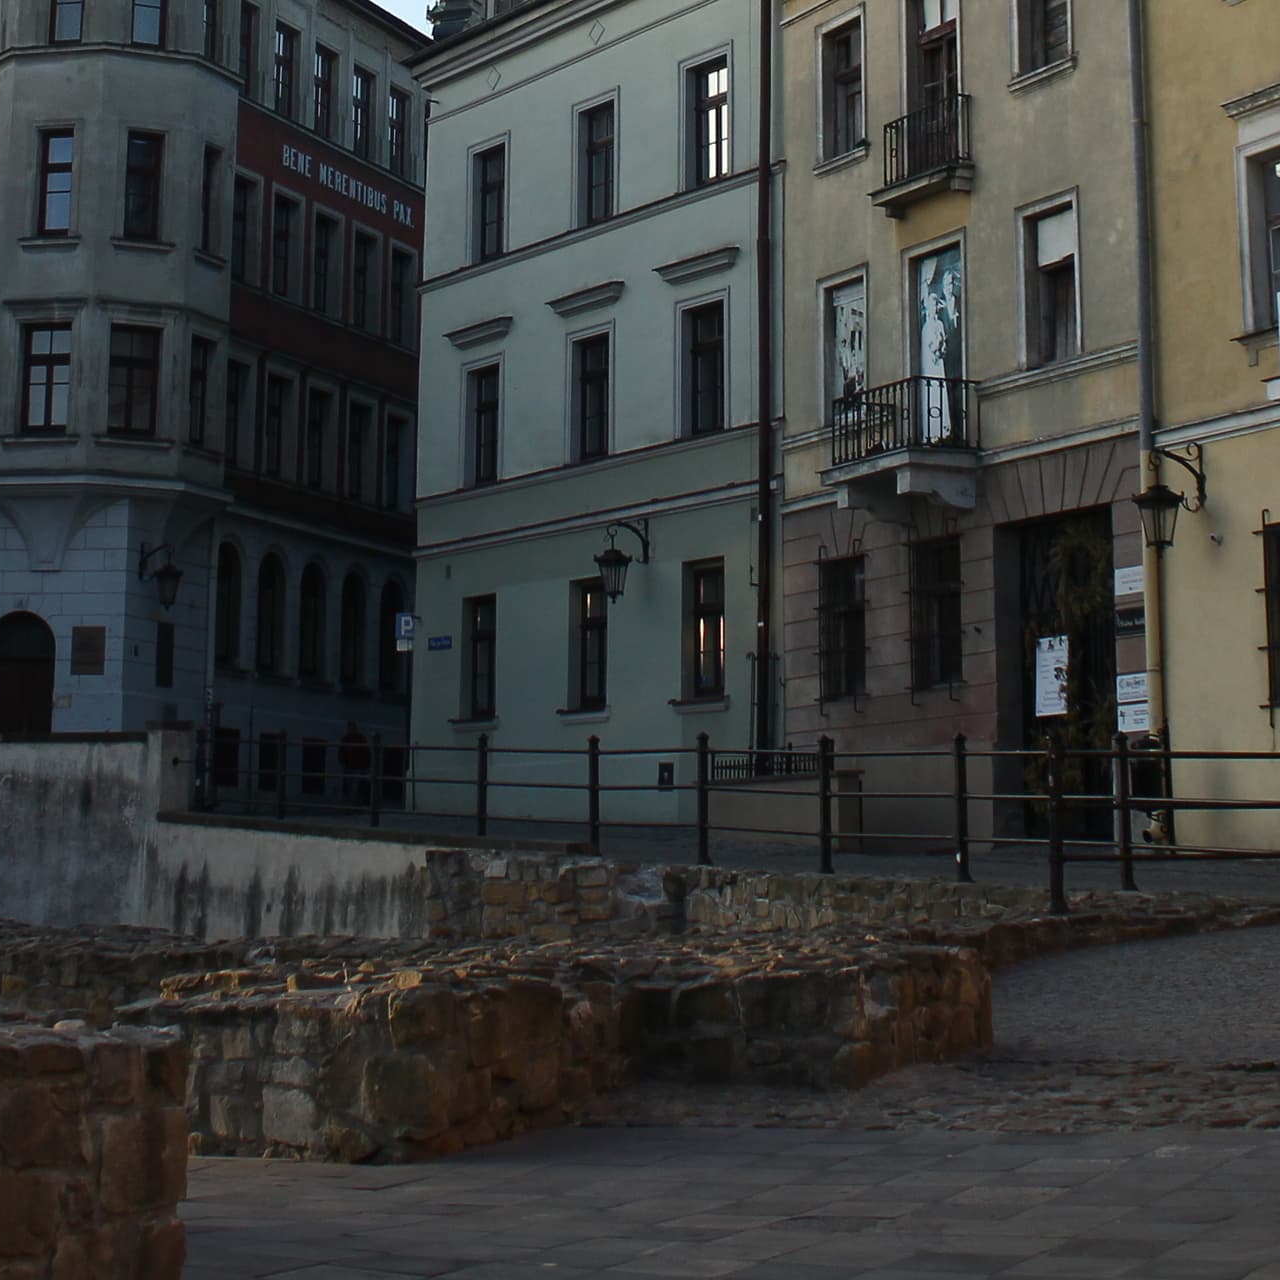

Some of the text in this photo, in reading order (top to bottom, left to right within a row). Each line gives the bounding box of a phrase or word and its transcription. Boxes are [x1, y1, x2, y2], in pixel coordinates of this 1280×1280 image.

[282, 144, 312, 177] BENE
[319, 163, 388, 214] MERENTIBUS
[401, 615, 413, 635] P
